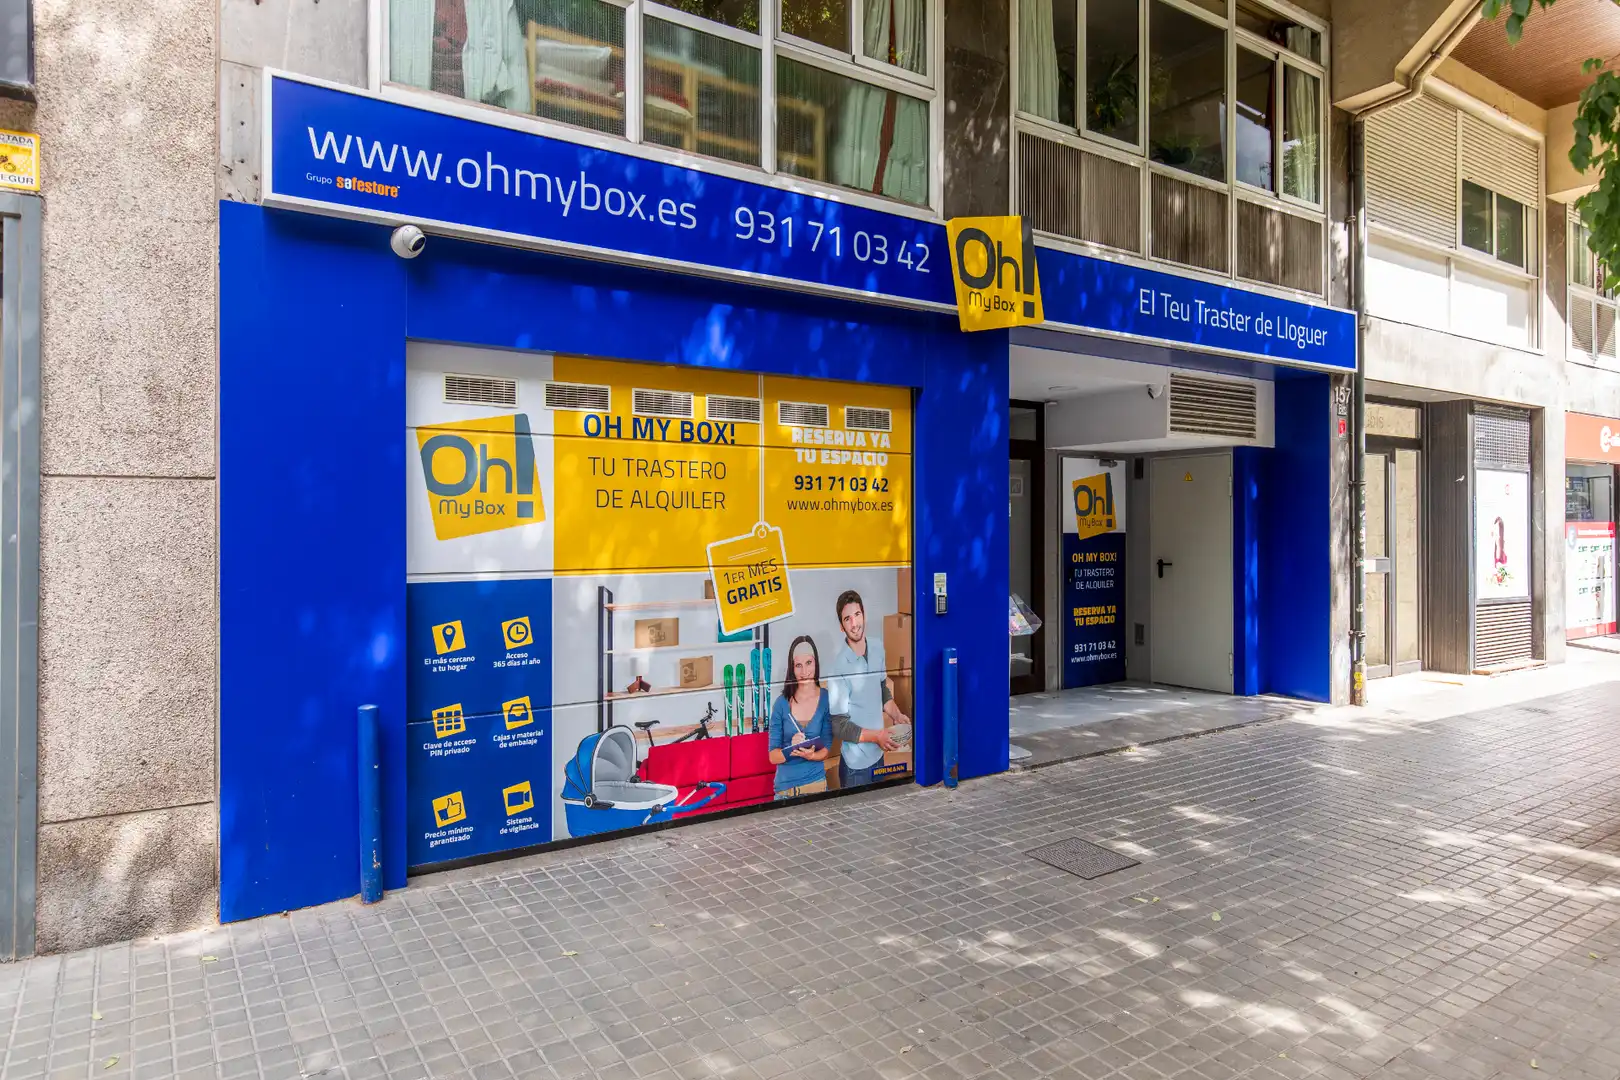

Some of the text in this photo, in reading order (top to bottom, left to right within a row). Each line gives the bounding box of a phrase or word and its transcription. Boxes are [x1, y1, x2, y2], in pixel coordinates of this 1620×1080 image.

[306, 172, 399, 198] Grupo safestore
[307, 126, 930, 273] www.ohmybox.es 931 71 03 42
[956, 216, 1036, 319] Oh!
[1139, 288, 1328, 349] El Teu Traster de Lloguer
[1334, 386, 1351, 404] 157
[584, 414, 735, 445] OH MY BOX!
[792, 428, 891, 448] RESERVA YA
[794, 448, 888, 466] TU ESPACIO
[420, 413, 535, 518] Oh!
[588, 456, 727, 480] TU TRASTERO
[794, 475, 889, 492] 931 71 03 42
[596, 489, 726, 511] DE ALQUILER
[787, 498, 894, 514] www.ohmybox.es
[1074, 472, 1113, 528] Oh!
[1072, 552, 1117, 563] OH MY BOX!
[723, 558, 778, 585] 1ER MES
[1074, 568, 1115, 578] TU TRASTERO
[727, 576, 782, 605] GRATIS
[1076, 580, 1114, 590] DE ALQUILER
[1073, 605, 1116, 616] RESERVA YA
[1074, 615, 1115, 626] TU ESPACIO
[1074, 640, 1116, 653] 931 71 03 42
[432, 657, 447, 665] más
[448, 656, 475, 664] cercano
[493, 660, 506, 668] 365
[507, 659, 521, 667] días
[529, 657, 541, 665] año
[506, 652, 528, 660] Acceso
[447, 664, 468, 672] hogar
[493, 734, 511, 742] Cajas
[517, 730, 544, 738] material
[508, 738, 538, 747] embalaje
[423, 738, 476, 750] Clave de acceso
[444, 747, 470, 757] privado
[506, 816, 532, 826] Sistema
[509, 822, 539, 833] vigilancia
[424, 826, 474, 839] Precio mínimo
[429, 834, 470, 848] garantizado
